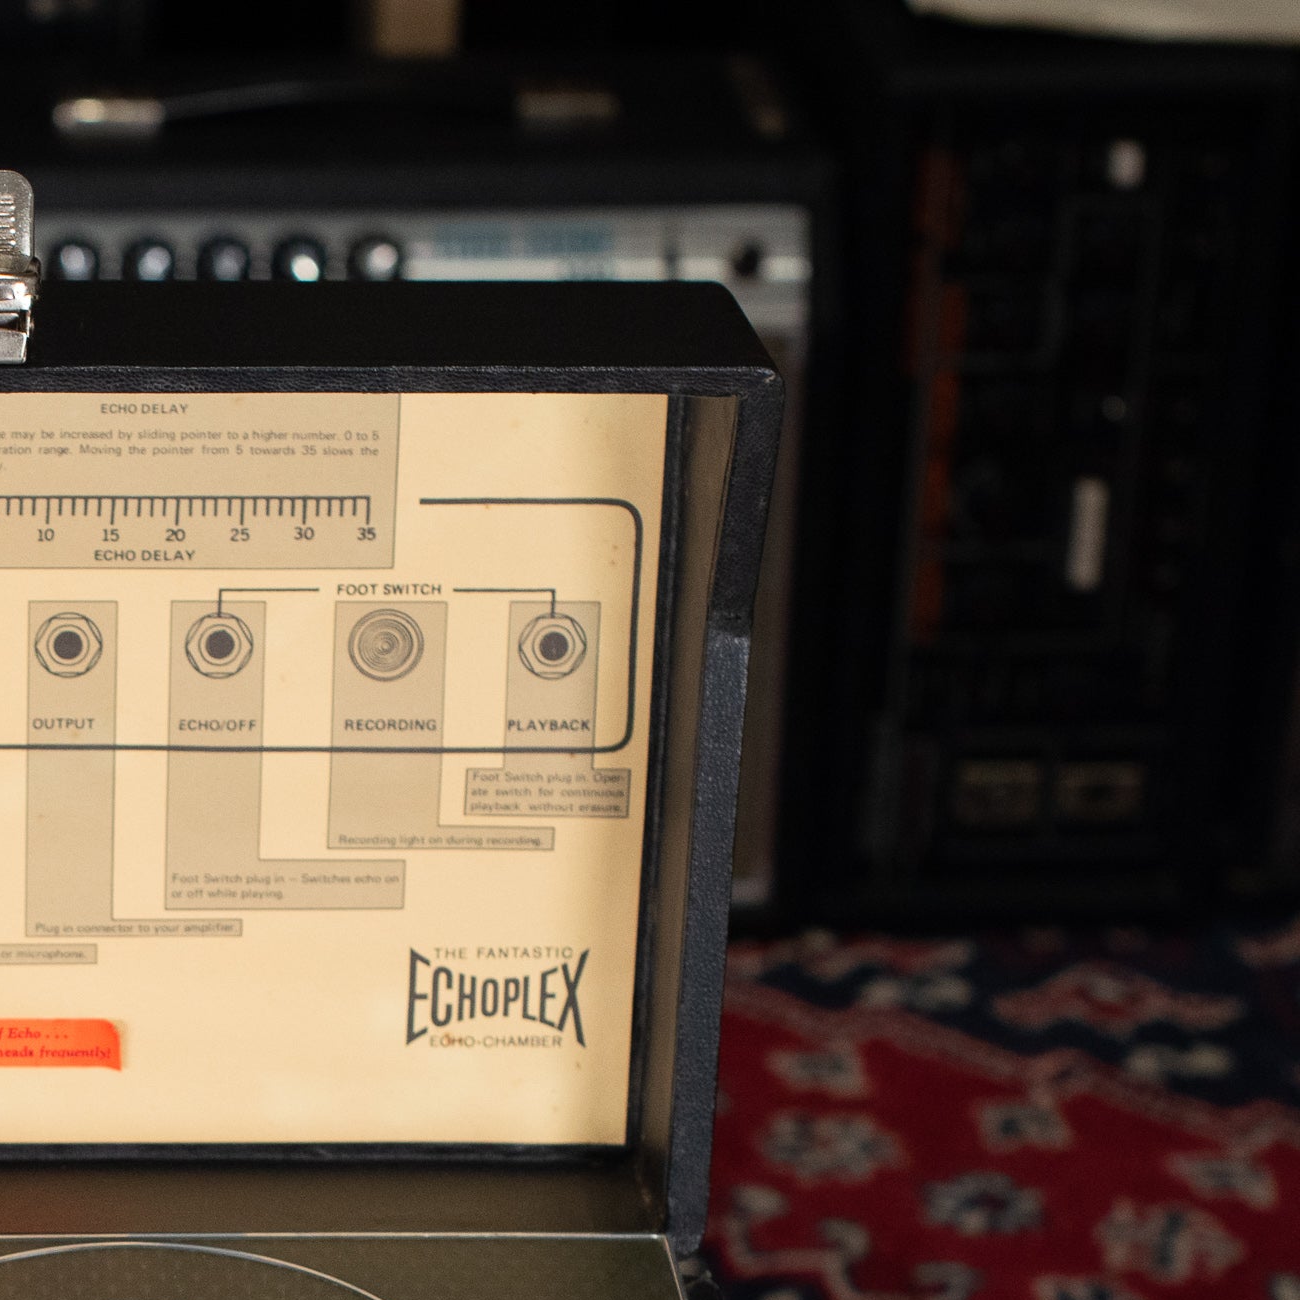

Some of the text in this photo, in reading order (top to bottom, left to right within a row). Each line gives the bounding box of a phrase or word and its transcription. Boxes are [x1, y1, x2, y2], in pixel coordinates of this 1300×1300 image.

[100, 403, 188, 414] ECHO DELAY
[11, 431, 35, 441] may
[41, 429, 55, 439] be
[59, 429, 113, 439] increased
[118, 429, 132, 441] by
[138, 429, 176, 441] sliding
[180, 430, 222, 441] pointer
[227, 431, 239, 440] to
[252, 430, 288, 441] higher
[292, 430, 337, 440] number.
[344, 430, 351, 440] 0
[356, 431, 368, 440] to
[372, 431, 380, 440] 5
[38, 446, 72, 457] range.
[79, 445, 122, 456] Moving
[128, 445, 147, 455] the
[153, 445, 194, 456] pointer
[201, 445, 229, 455] from
[236, 445, 244, 455] 5
[250, 445, 295, 455] towards
[301, 445, 317, 455] 35
[322, 445, 353, 455] slows
[360, 445, 379, 455] the
[38, 528, 55, 541] 10
[102, 528, 120, 541] 15
[165, 528, 186, 541] 20
[230, 528, 250, 541] 25
[294, 527, 314, 540] 30
[357, 527, 376, 540] 35
[94, 549, 195, 561] ECHO DELAY
[337, 584, 442, 595] FOOT SWITCH
[32, 718, 95, 730] OUTPUT
[179, 719, 256, 732] ECHO/OFF
[344, 719, 437, 731] RECORDING
[508, 719, 591, 731] PLAYBACK
[434, 947, 573, 959] THE FANTASTIC
[406, 947, 590, 1048] ECHOPLEX
[7, 1028, 41, 1039] Echo
[430, 1035, 563, 1048] ECHO-CHAMBER
[40, 1046, 111, 1060] frequently!
